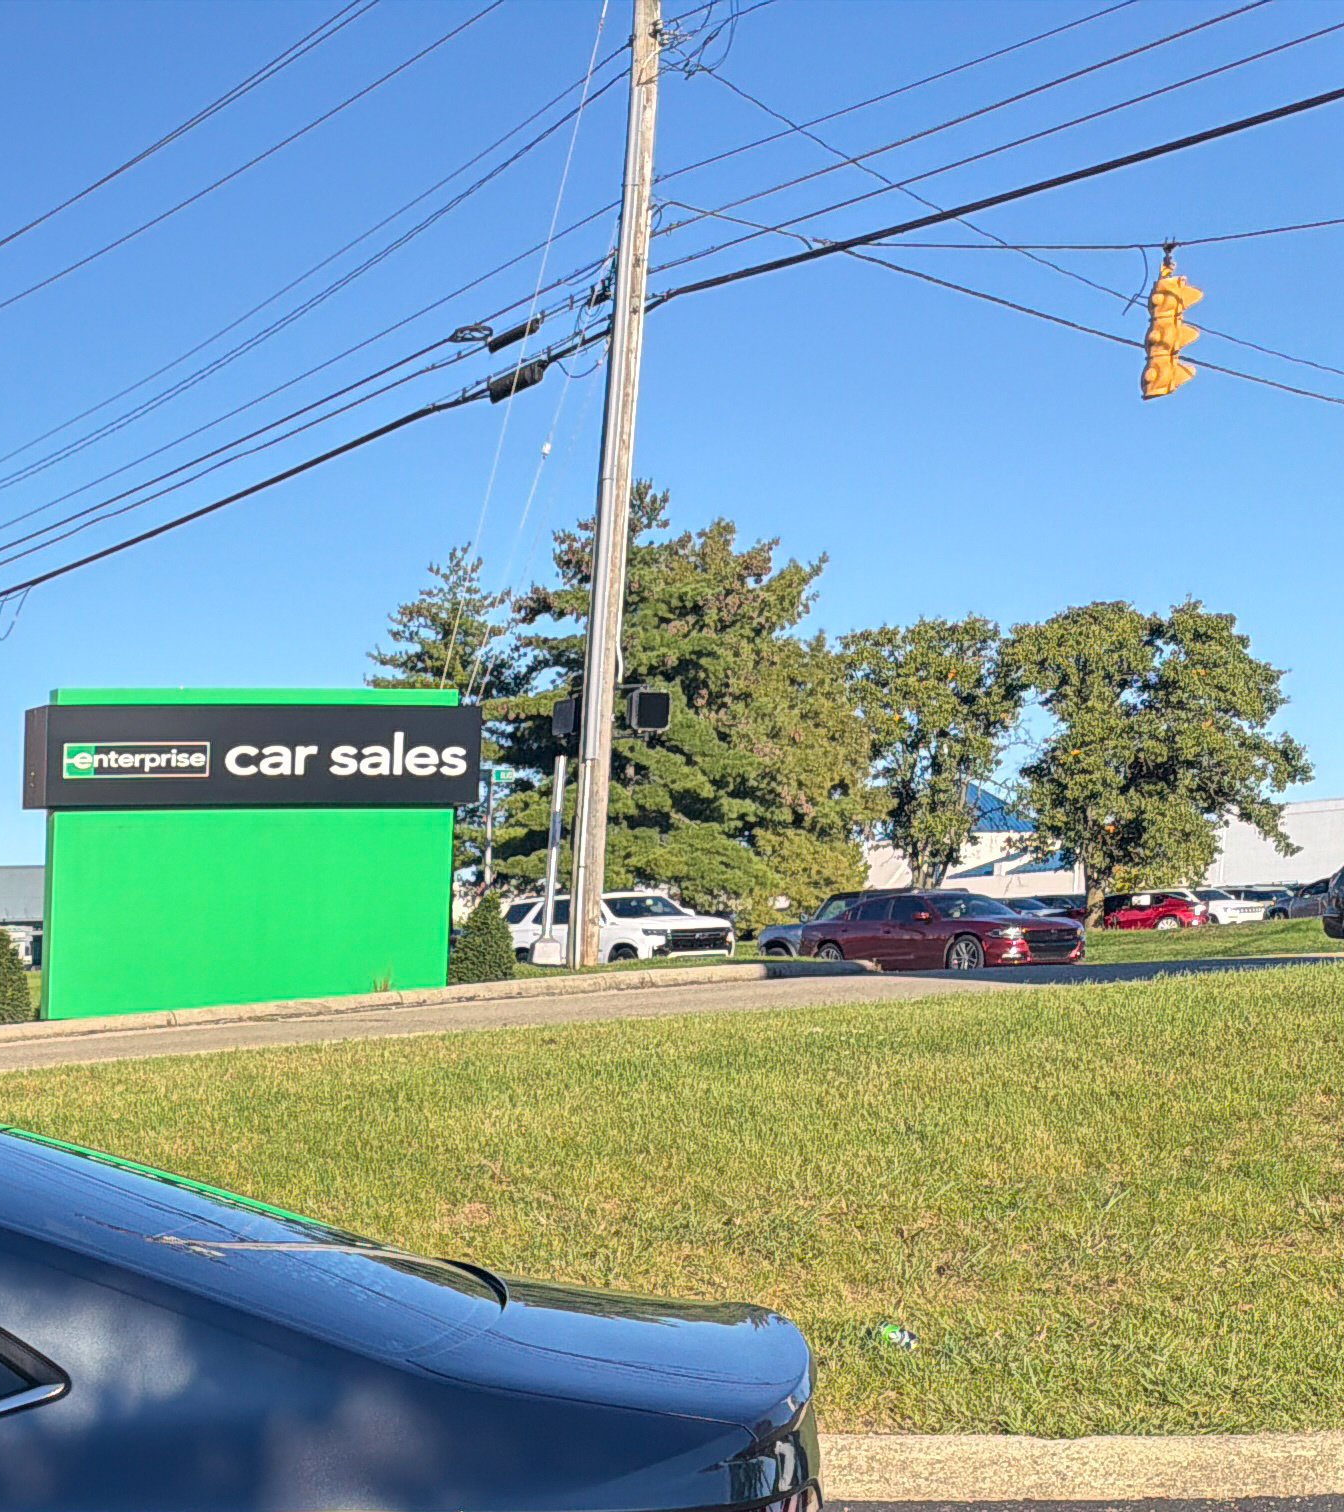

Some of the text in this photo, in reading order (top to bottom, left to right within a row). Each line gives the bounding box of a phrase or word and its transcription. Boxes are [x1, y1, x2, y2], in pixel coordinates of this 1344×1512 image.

[70, 731, 467, 777] enterprise car sales
